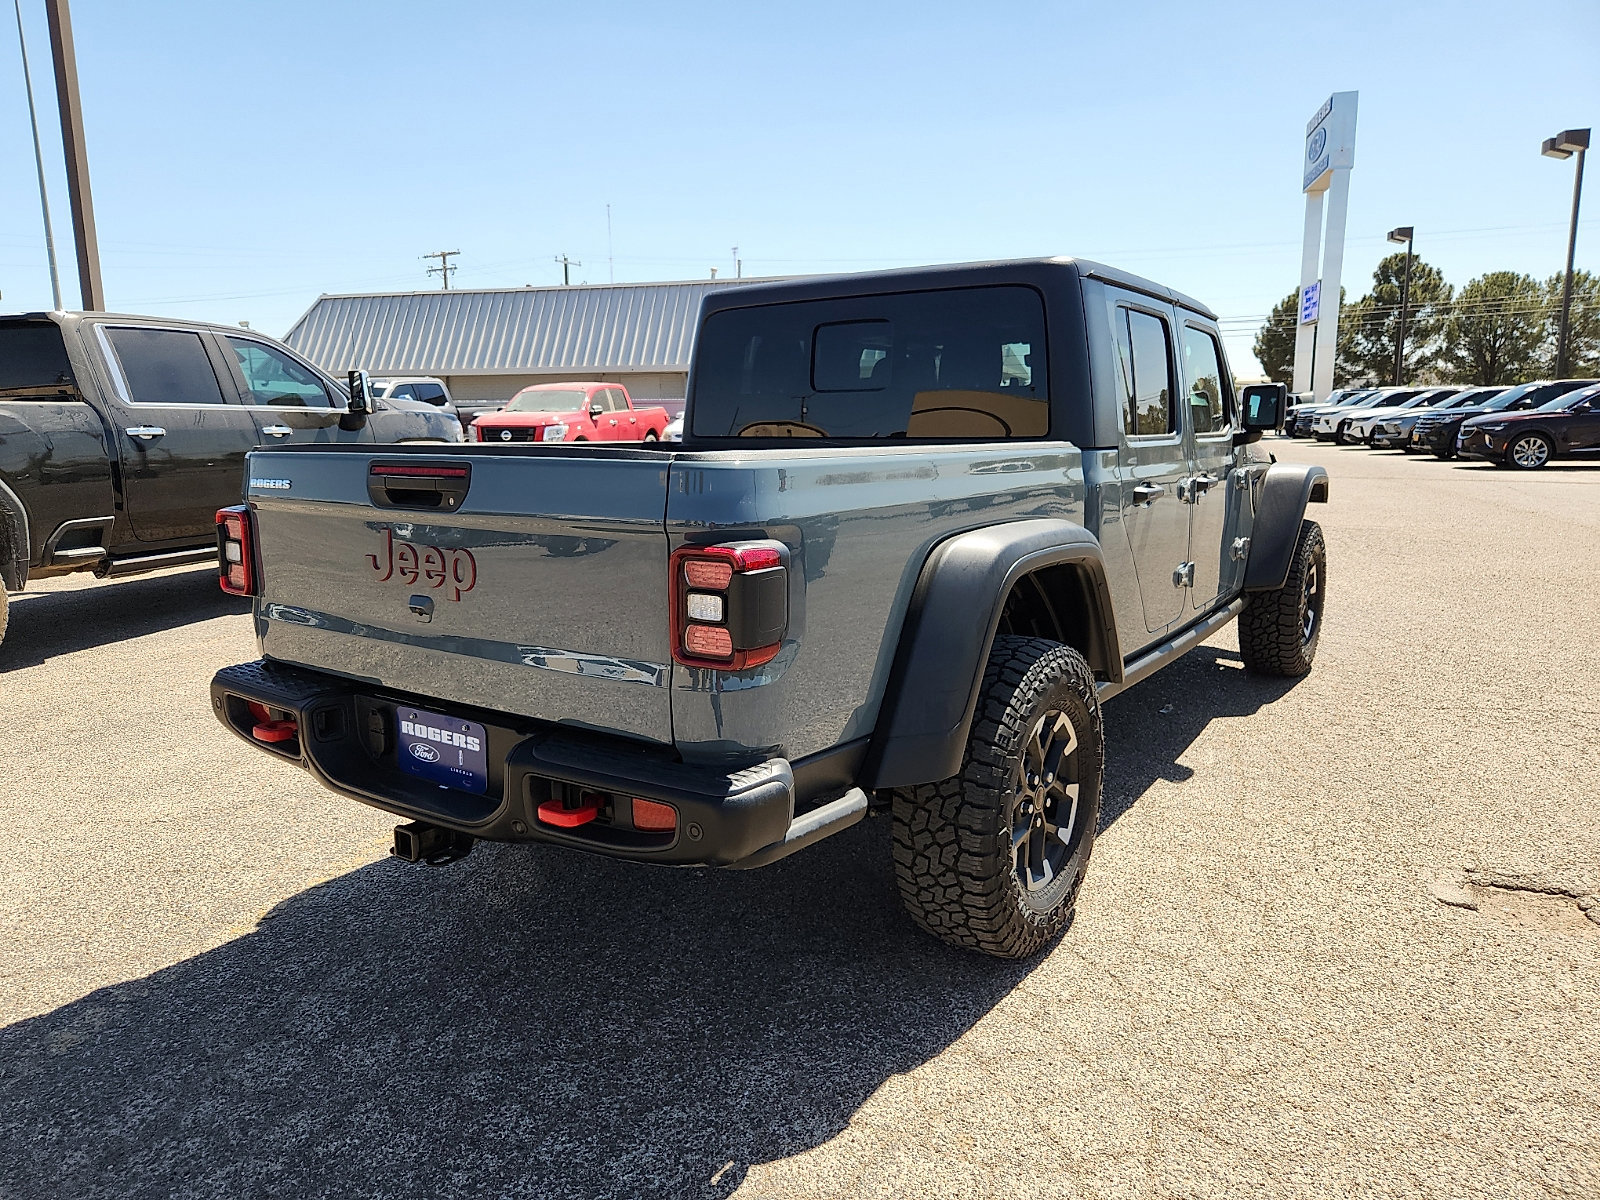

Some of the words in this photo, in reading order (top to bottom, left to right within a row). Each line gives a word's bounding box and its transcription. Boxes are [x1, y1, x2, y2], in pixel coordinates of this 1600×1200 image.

[250, 478, 292, 489] ROGERS
[364, 527, 477, 602] Jeep
[401, 721, 480, 752] ROGERS
[414, 744, 435, 761] Ford
